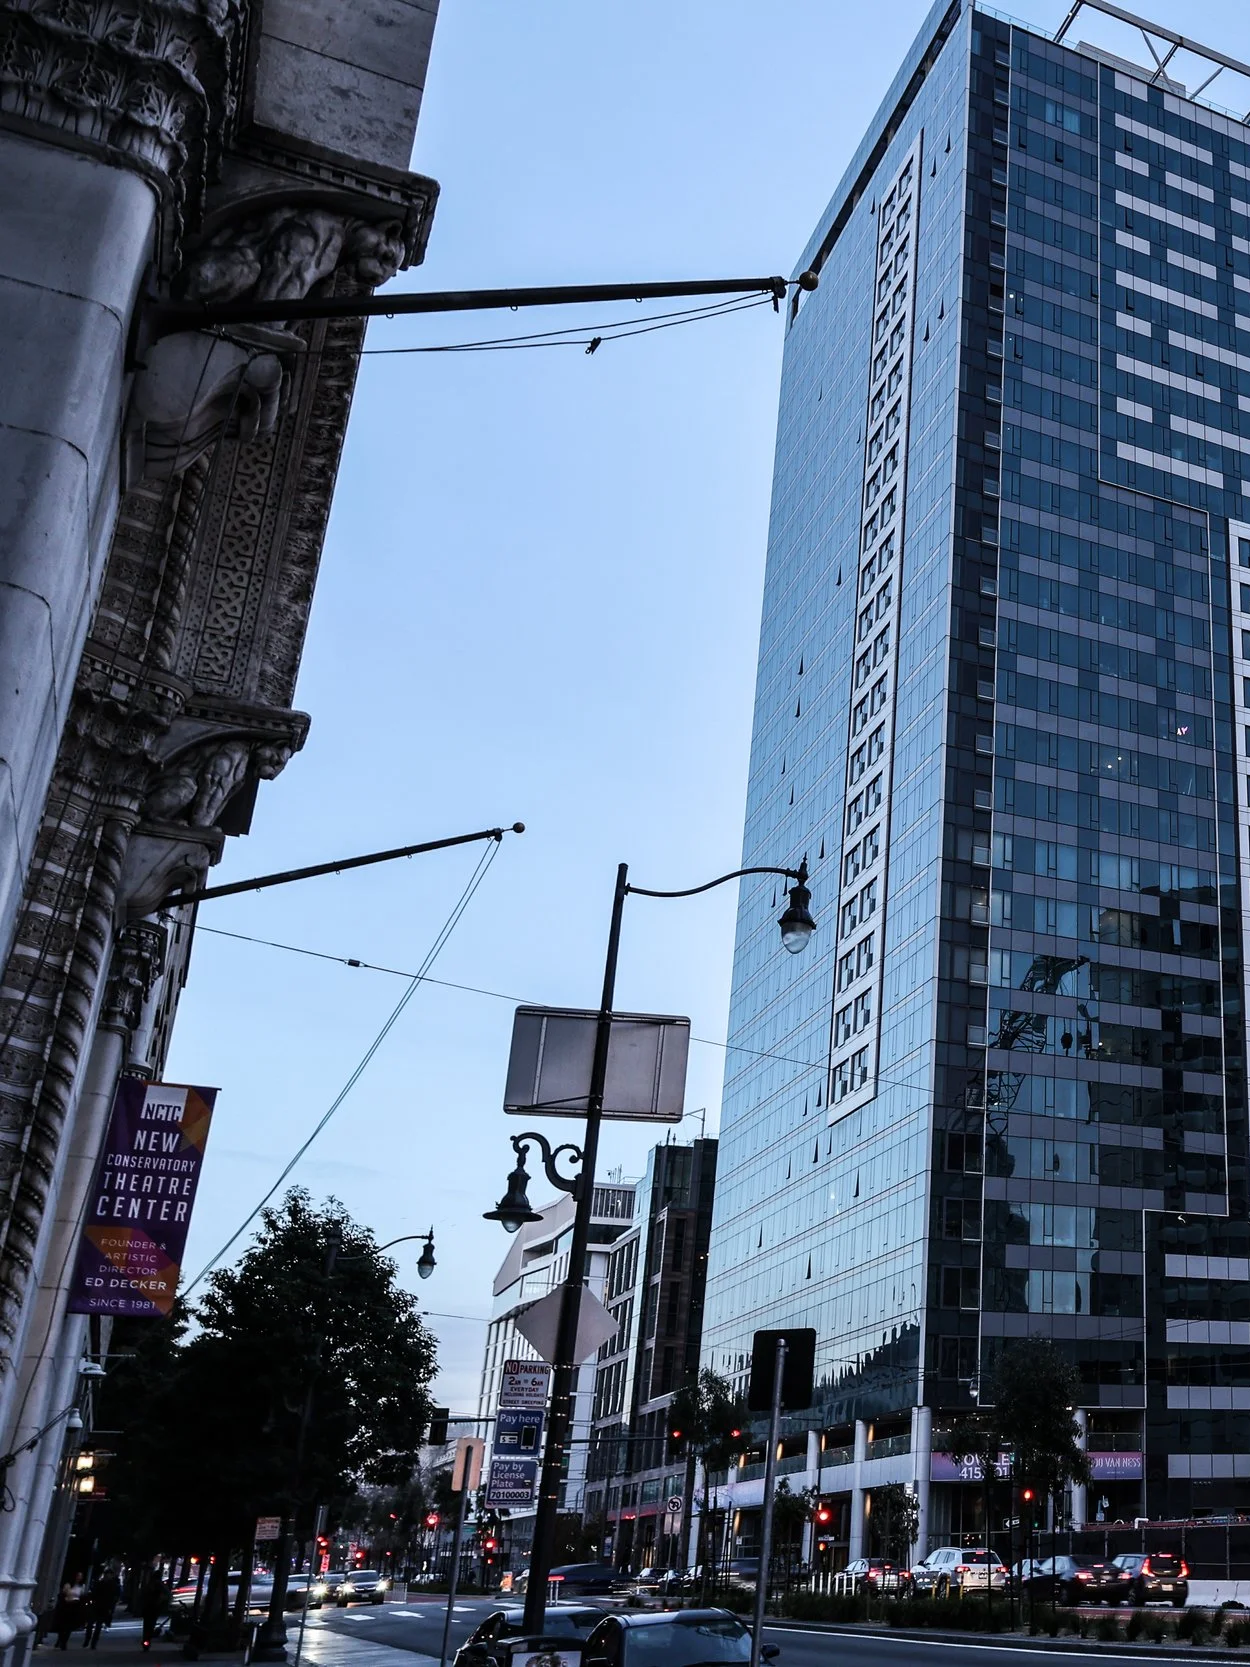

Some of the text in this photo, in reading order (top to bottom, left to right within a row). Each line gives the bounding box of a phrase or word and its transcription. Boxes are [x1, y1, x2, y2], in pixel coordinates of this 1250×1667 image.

[142, 1103, 182, 1122] NCTC
[134, 1130, 180, 1153] NEW
[107, 1154, 196, 1172] CONSERVATORY
[104, 1172, 193, 1196] THEATRE
[96, 1195, 188, 1222] CENTER
[101, 1238, 157, 1250] FOUNDER
[104, 1252, 158, 1263] ARTISTIC
[99, 1265, 158, 1276] DIRECTOR
[85, 1277, 168, 1291] ED DECKER
[89, 1298, 156, 1309] SINCE 1981
[504, 1361, 549, 1375] NO PARKING
[500, 1413, 540, 1424] Pay here
[493, 1462, 524, 1471] Pay by
[1105, 1457, 1121, 1468] VAN
[1122, 1457, 1141, 1468] NESS
[492, 1471, 526, 1479] License
[491, 1480, 514, 1488] Plate
